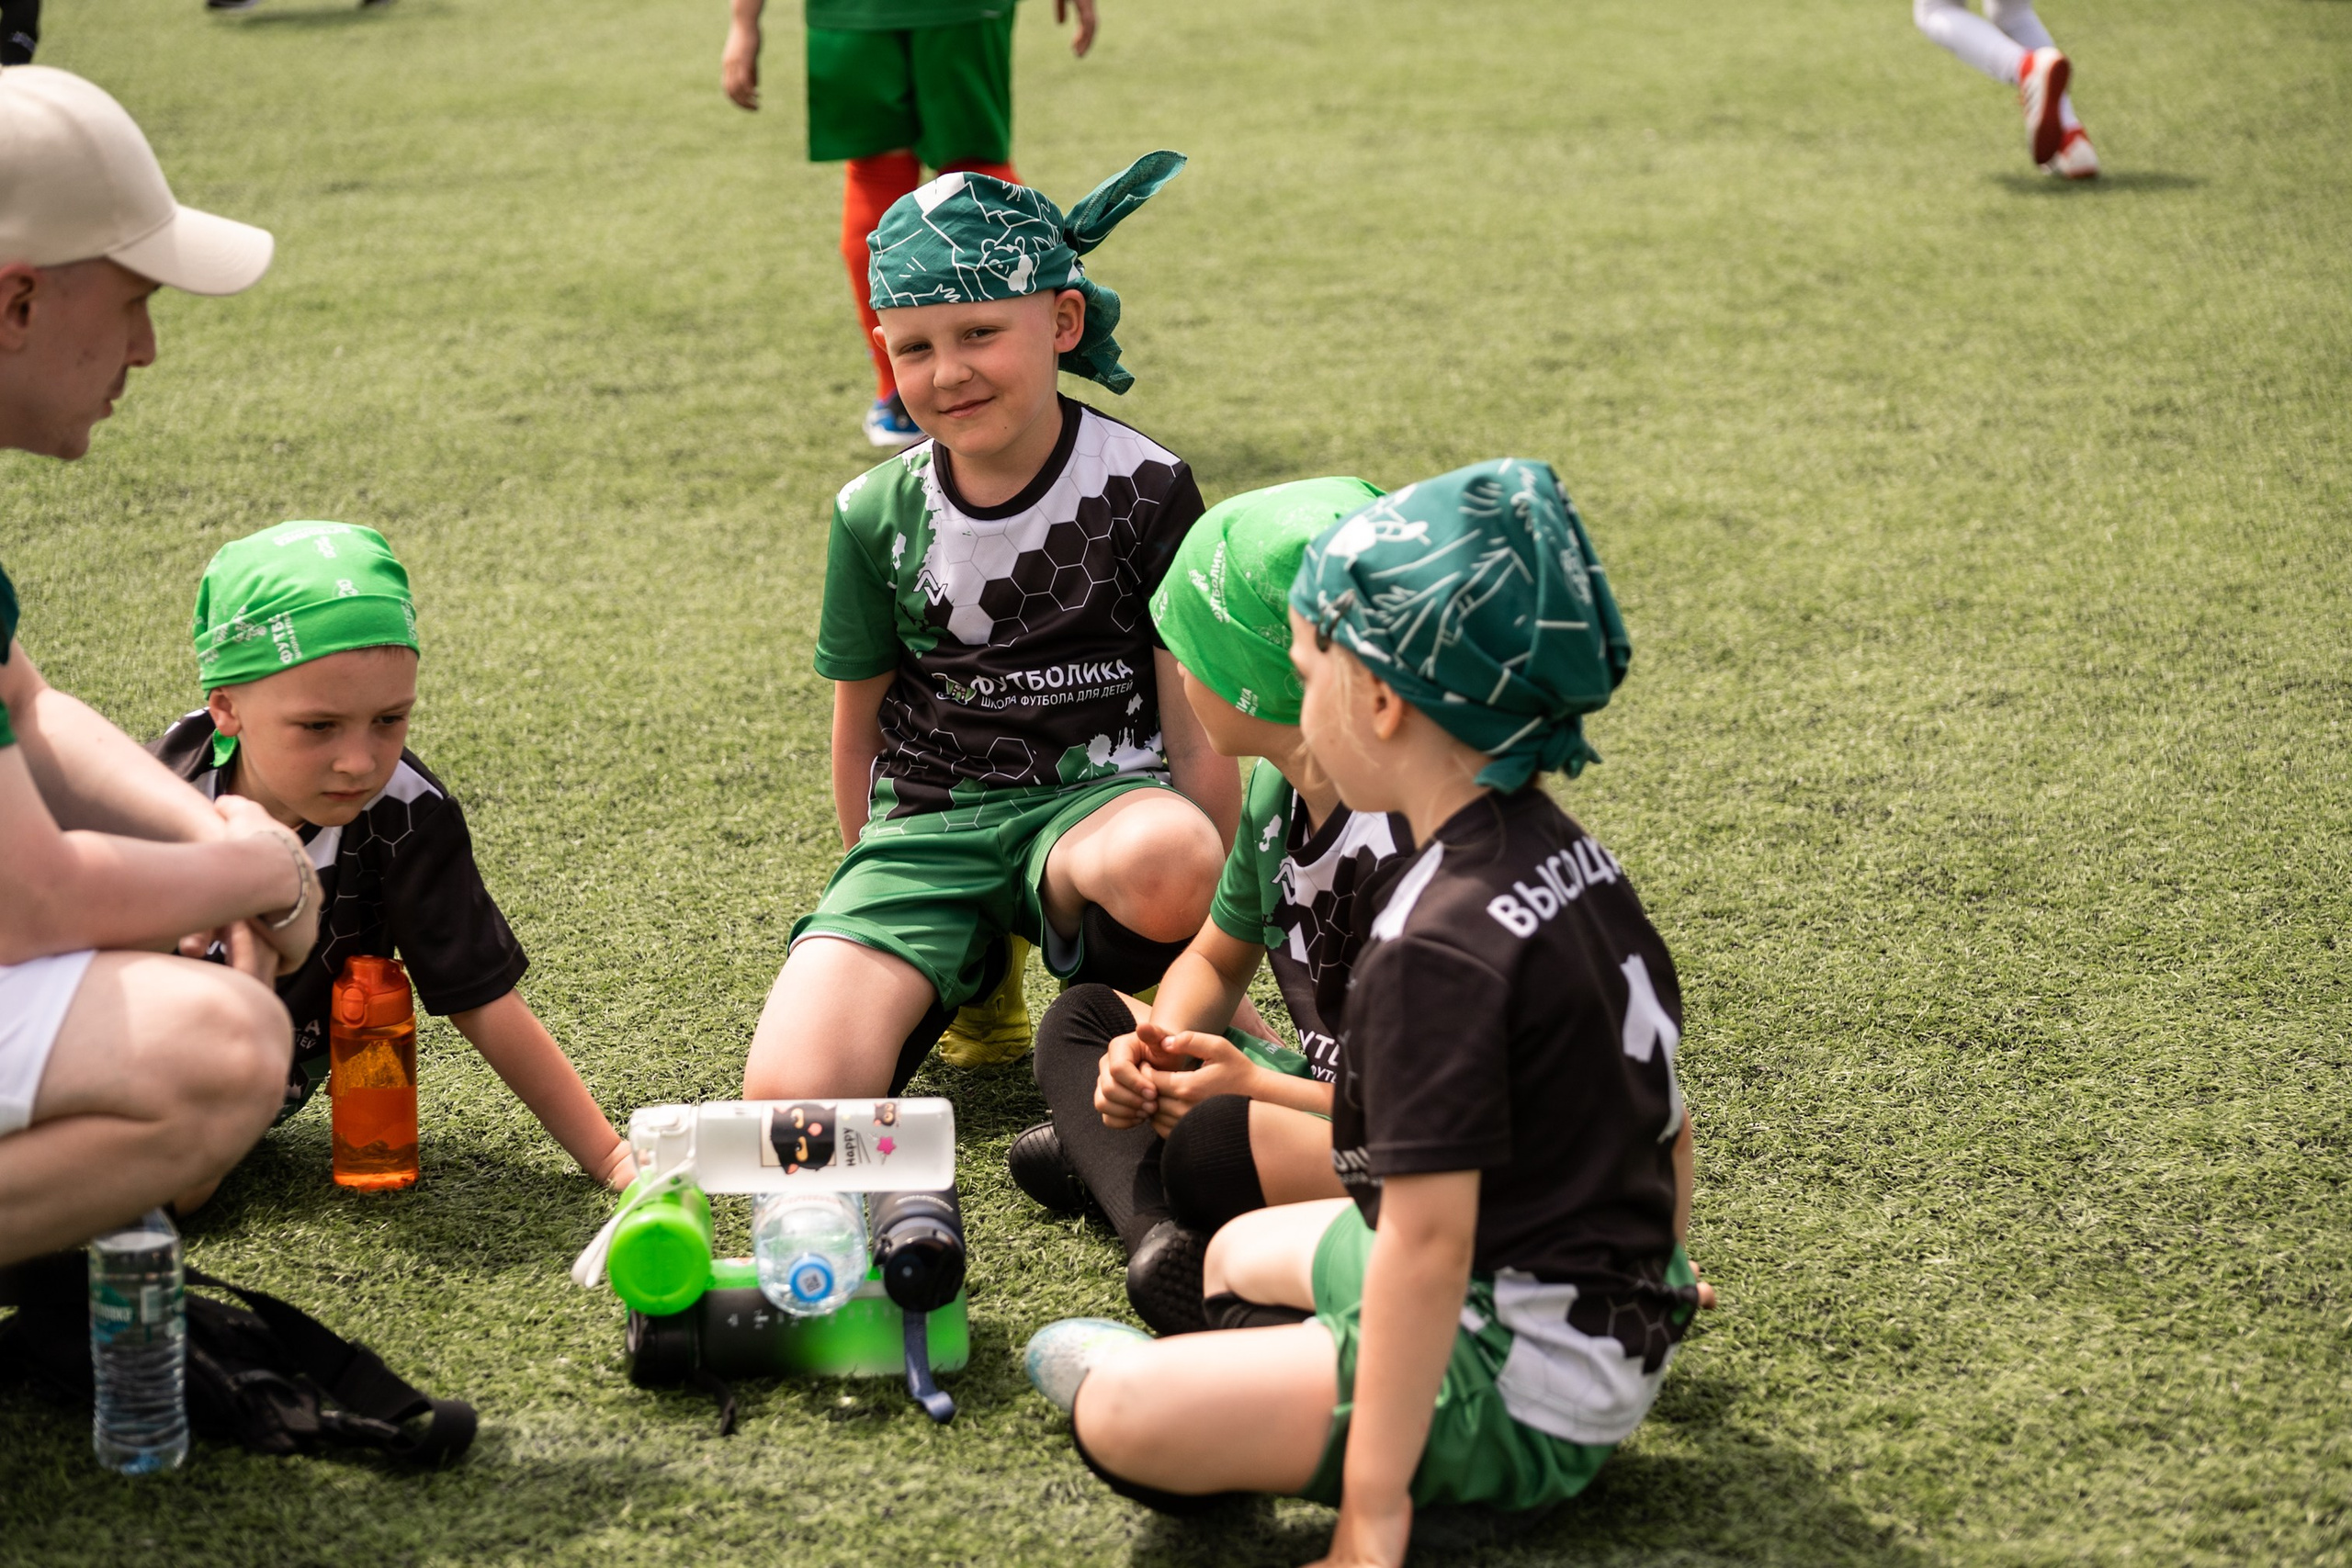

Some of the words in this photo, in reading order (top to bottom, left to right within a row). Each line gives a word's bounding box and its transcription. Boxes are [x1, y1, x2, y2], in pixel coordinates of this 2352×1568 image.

[970, 659, 1135, 696] ФУТБОЛИКА
[980, 694, 1017, 711] ШКОЛА
[1020, 692, 1075, 707] ФУТБОЛА
[1076, 688, 1101, 703] ДЛЯ
[1102, 678, 1135, 699] ДЕТЕЙ
[843, 1127, 857, 1167] Happy
